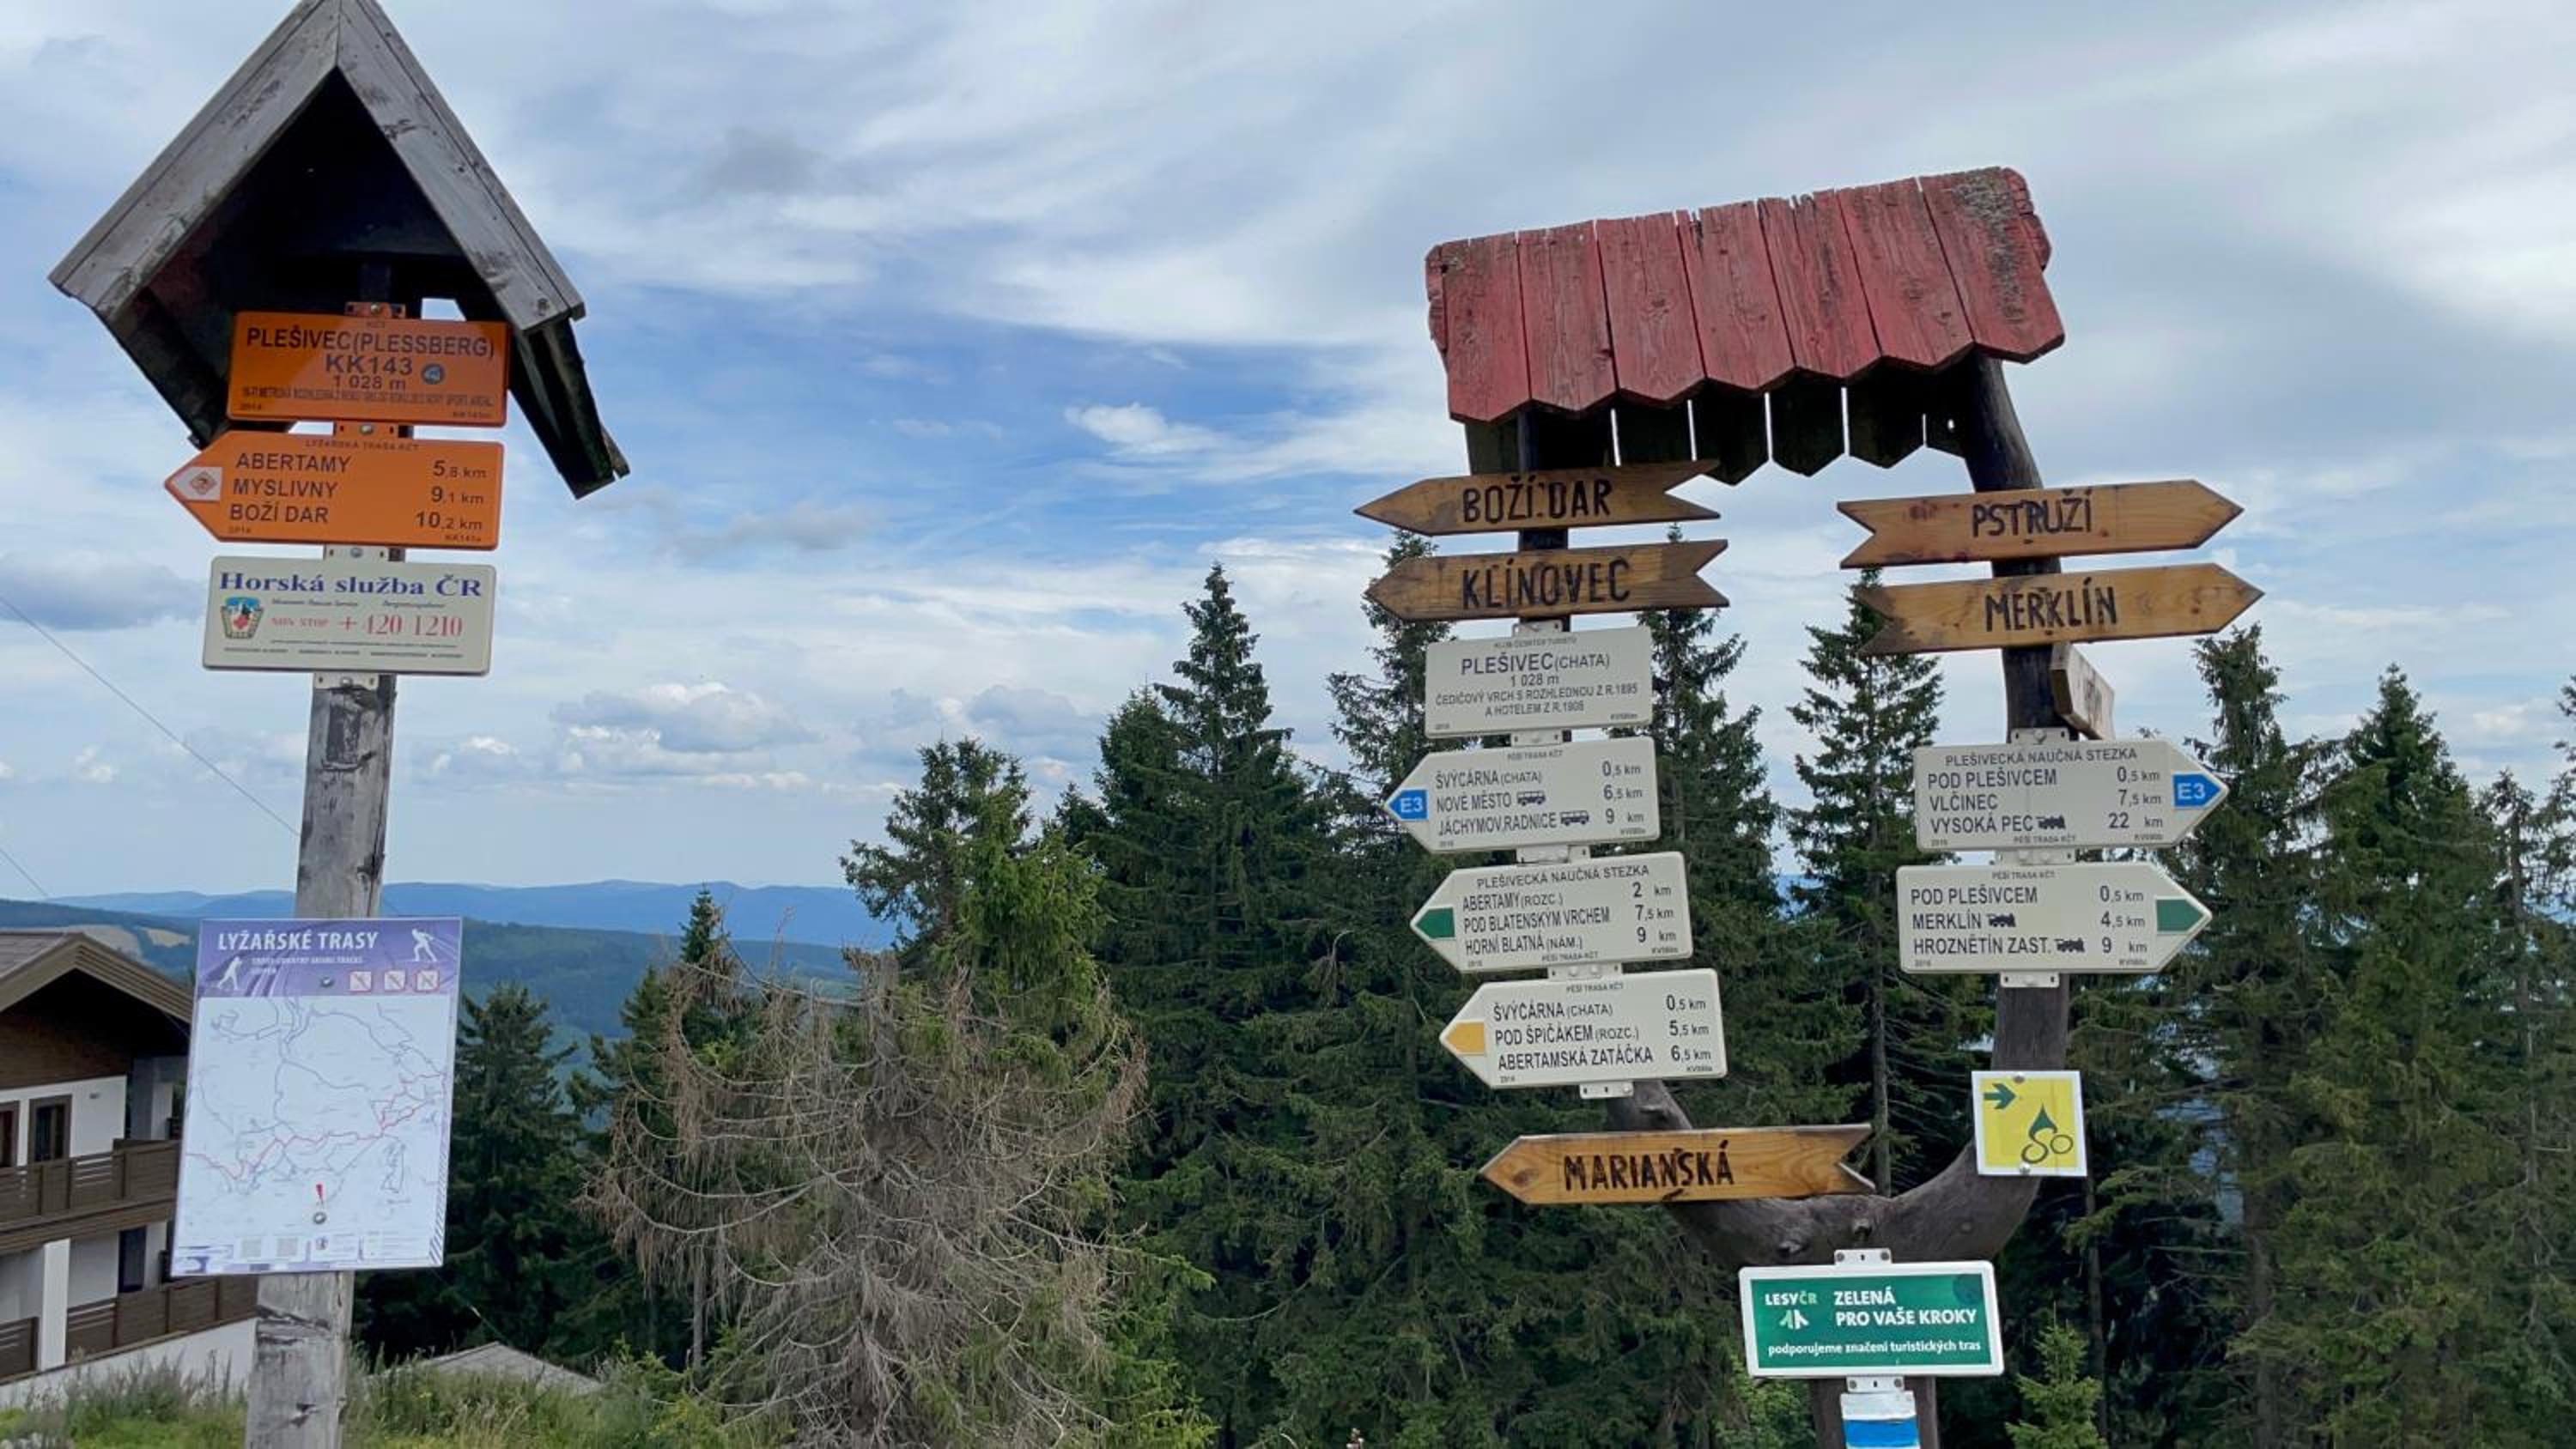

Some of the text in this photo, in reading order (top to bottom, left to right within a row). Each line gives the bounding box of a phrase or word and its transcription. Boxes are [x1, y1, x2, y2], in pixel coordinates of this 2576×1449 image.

[326, 354, 413, 375] KK143
[349, 375, 383, 391] 028
[389, 379, 407, 391] m
[236, 452, 351, 473] ABERTAMY
[464, 467, 488, 478] km
[232, 478, 338, 498] MYSLIVNY
[461, 492, 484, 504] km
[1462, 475, 1613, 524] BOŽÍ DAR
[229, 501, 329, 523] BOŽÍ DAR
[1973, 488, 2093, 538] PSTRUŽÍ
[459, 518, 483, 530] km
[220, 572, 482, 597] Horská služba ČR
[1462, 555, 1631, 610] KLÍNOVEC
[1985, 577, 2118, 633] MERKLÍN
[413, 614, 464, 637] 1210
[1521, 673, 1544, 686] 028
[1546, 674, 1560, 685] m
[1487, 691, 1514, 702] VRCH
[1485, 706, 1492, 718] A
[1494, 703, 1542, 716] HOTELEM
[1945, 748, 2137, 767] PLEŠIVECKÁ NAUČNÁ STEZKA
[1623, 764, 1642, 776] km
[1928, 767, 2057, 790] POD PLEŠIVCEM
[2142, 770, 2160, 781] km
[1625, 788, 1643, 800] km
[2142, 793, 2162, 804] km
[2177, 782, 2206, 800] E3
[1400, 797, 1424, 813] E3
[1436, 790, 1512, 813] NOVÉ MĚSTO
[1929, 791, 1999, 811] VLČINEC
[1605, 809, 1644, 824] 9 km
[1930, 812, 2034, 834] VYSOKÁ PEC
[2108, 812, 2164, 828] 22 km
[1476, 864, 1649, 889] PLEŠIVECKÁ NAUČNÁ STEZKA
[1632, 882, 1672, 898] 2 km
[1911, 883, 2038, 905] POD PLEŠIVCEM
[2125, 890, 2144, 902] km
[1464, 906, 1611, 933] POD BLATENSKÝM VRCHEM
[1656, 908, 1674, 919] km
[1912, 908, 1982, 930] MERKLÍN
[2126, 916, 2146, 927] km
[218, 930, 380, 951] LYŽAŘSKÉ TRASY
[1466, 935, 1499, 955] HORNÍ
[1503, 931, 1545, 953] BLATNÁ
[1637, 927, 1676, 943] 9 km
[1913, 934, 2051, 955] HROZNĚTÍN ZAST.
[2101, 937, 2148, 954] 9 km
[1493, 999, 1565, 1022] ŠVÝCÁRNA
[1688, 997, 1707, 1009] km
[1495, 1029, 1522, 1046] POD
[1526, 1022, 1593, 1045] ŠPIČÁKEM
[1692, 1023, 1710, 1036] km
[1498, 1043, 1655, 1070] ABERTAMSKÁ ZATÁČKA
[1693, 1049, 1712, 1061] km
[1833, 1287, 1897, 1306] ZELENÁ
[1836, 1307, 1978, 1327] PRO VAŠE KROKY
[1768, 1339, 1981, 1357] podporujeme značení turistických tras
